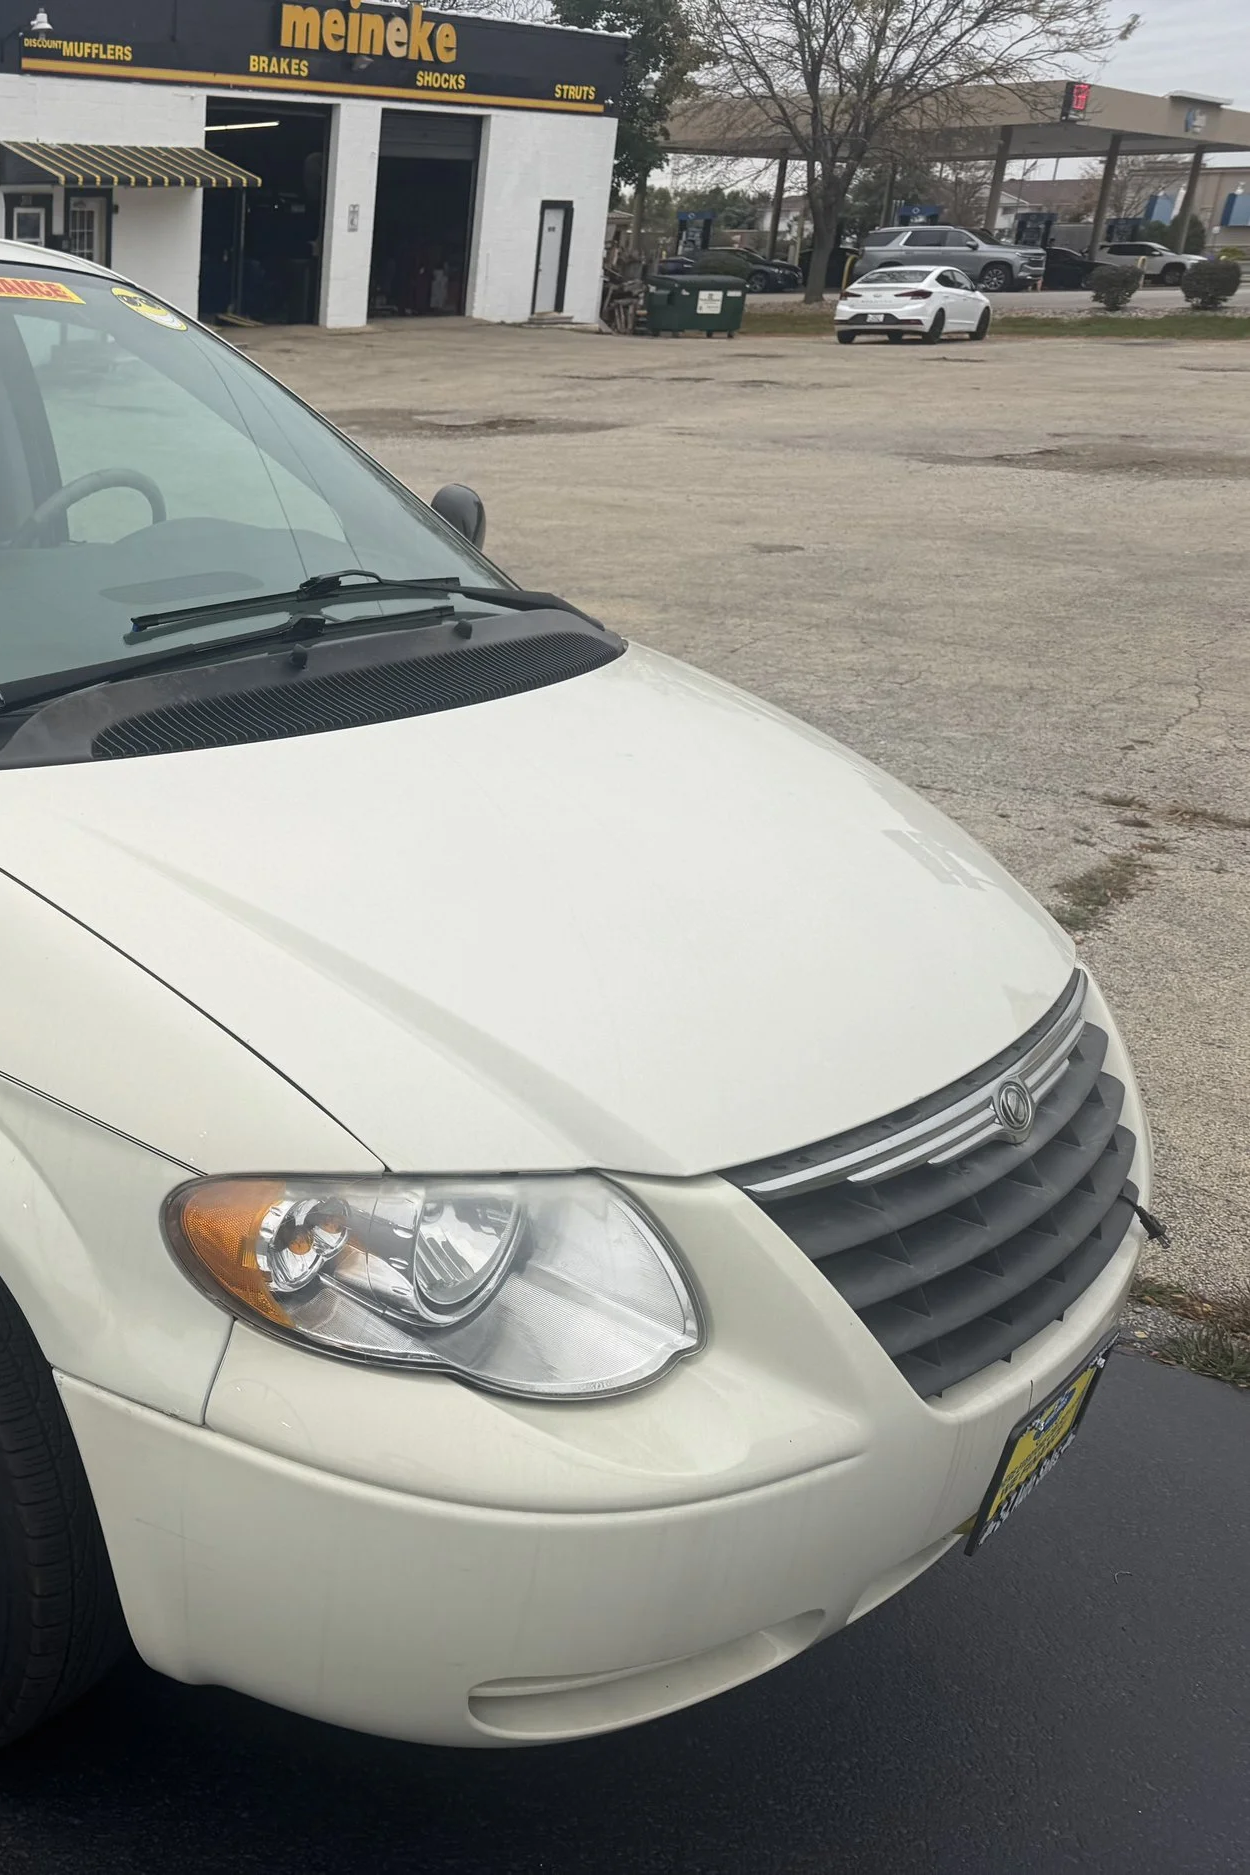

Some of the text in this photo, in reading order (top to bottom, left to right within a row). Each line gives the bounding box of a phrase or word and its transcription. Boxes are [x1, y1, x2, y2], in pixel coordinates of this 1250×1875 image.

[280, 0, 457, 63] meineke
[23, 38, 132, 61] DISCOUNT MUFFLERS
[249, 55, 309, 77] BRAKES
[416, 70, 466, 90] SHOCKS
[554, 84, 596, 100] STRUTS
